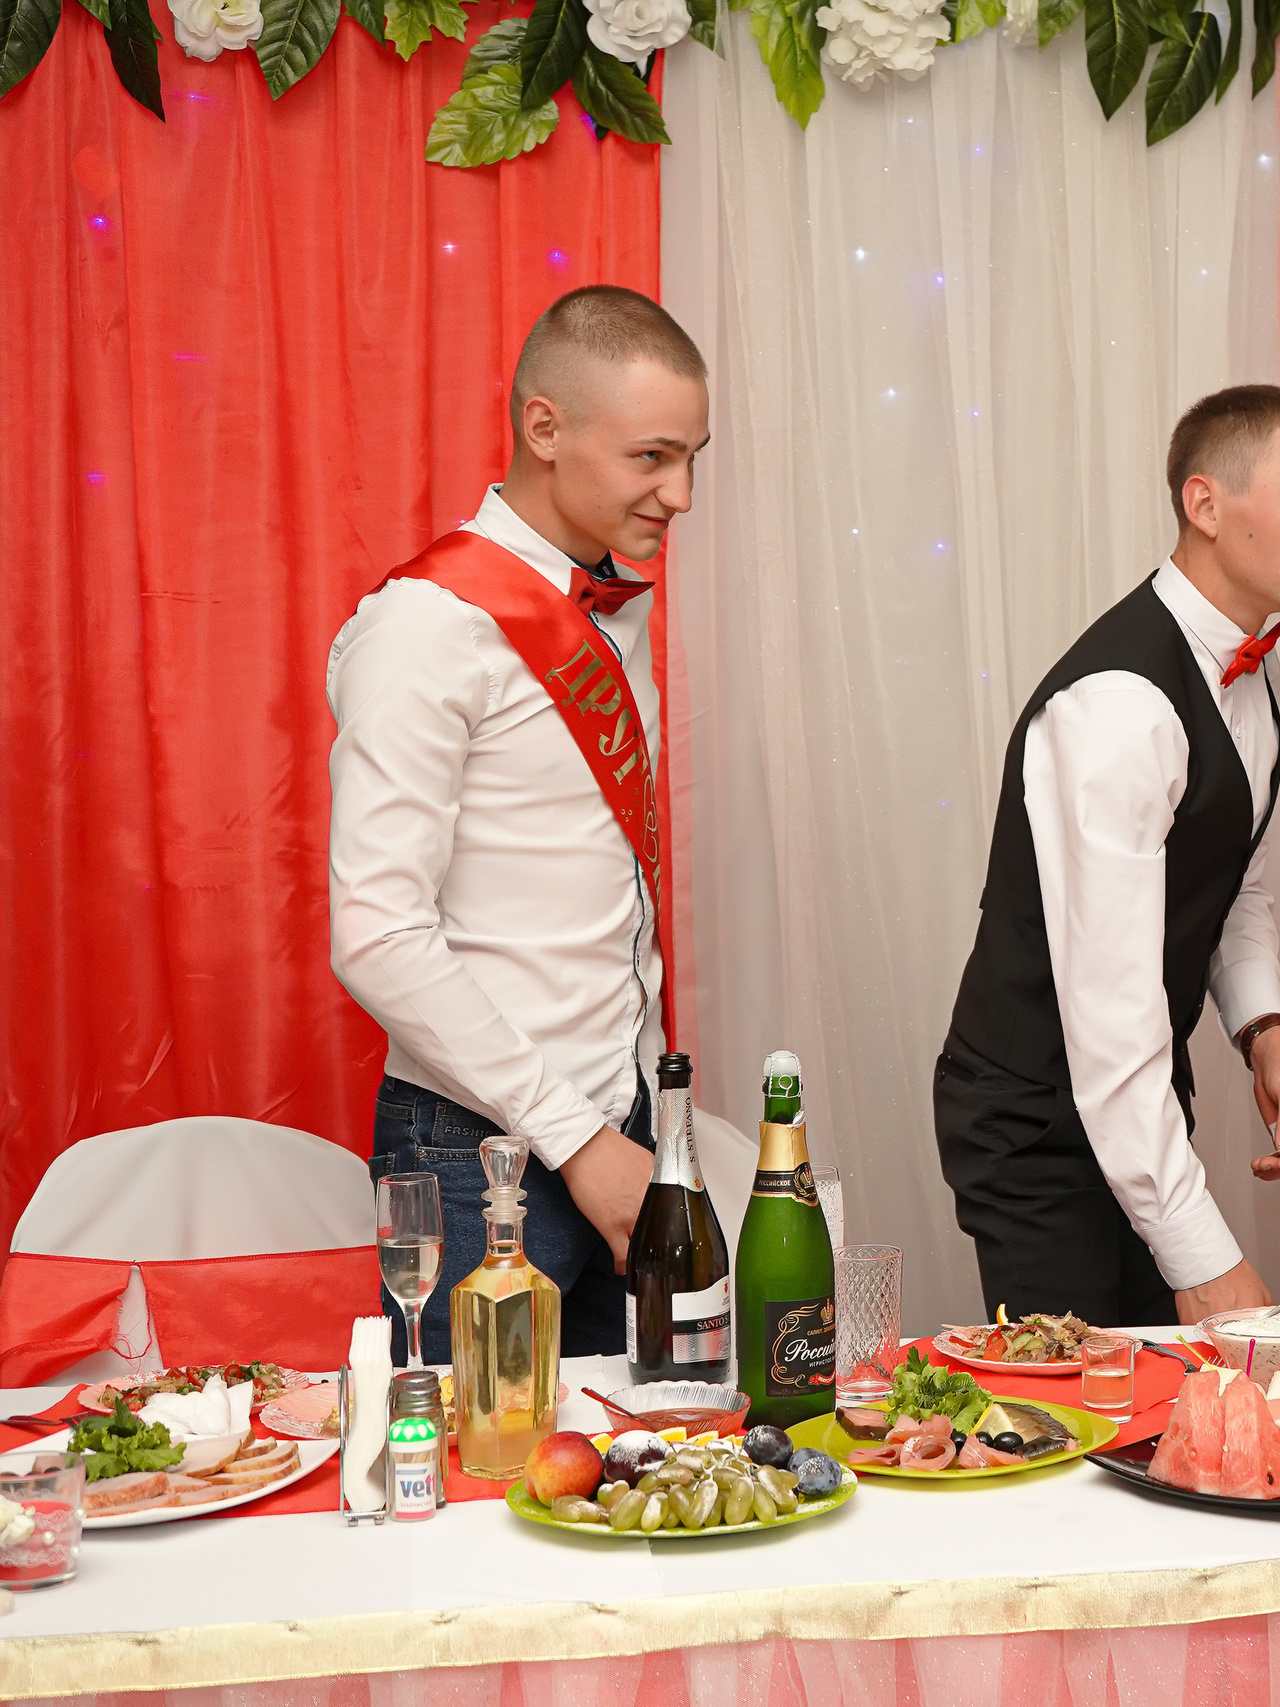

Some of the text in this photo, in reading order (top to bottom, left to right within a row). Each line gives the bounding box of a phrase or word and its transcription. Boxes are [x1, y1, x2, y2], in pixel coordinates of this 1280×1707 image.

[545, 638, 649, 786] ДРУГ
[685, 1096, 694, 1152] STEFANO
[696, 1316, 725, 1331] SANTO
